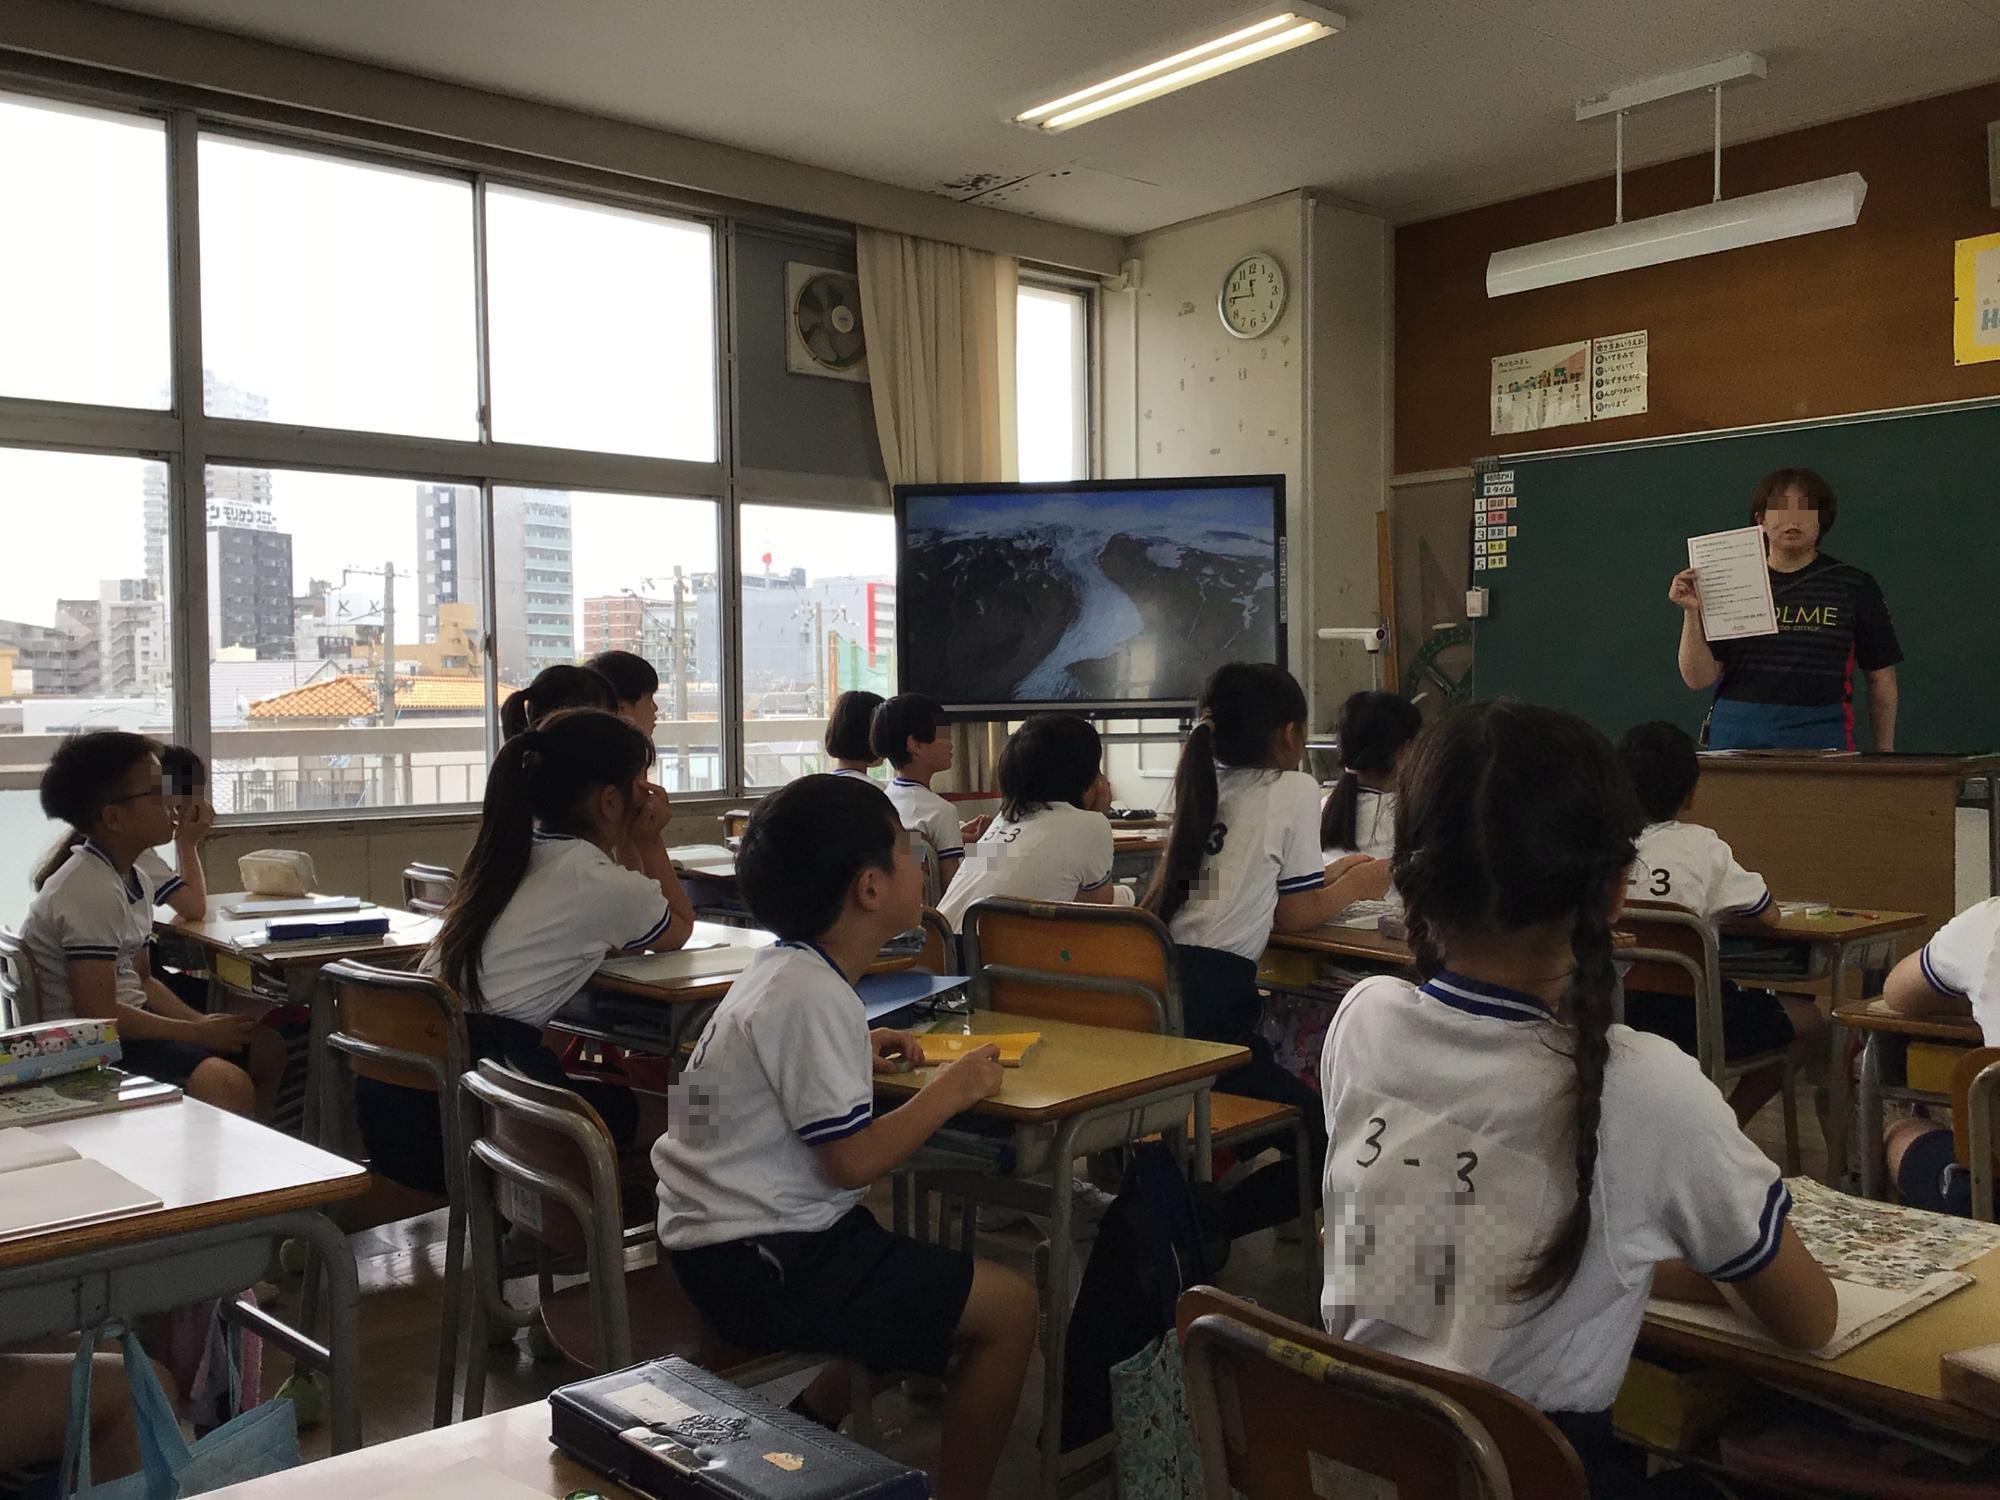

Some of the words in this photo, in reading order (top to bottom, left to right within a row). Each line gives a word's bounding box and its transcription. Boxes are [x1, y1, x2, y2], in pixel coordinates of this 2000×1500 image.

[1981, 308, 2000, 332] H
[1479, 502, 1483, 510] 1
[1477, 516, 1484, 525] 2
[1477, 531, 1484, 540] 3
[1477, 545, 1484, 554] 4
[1477, 560, 1484, 569] 5
